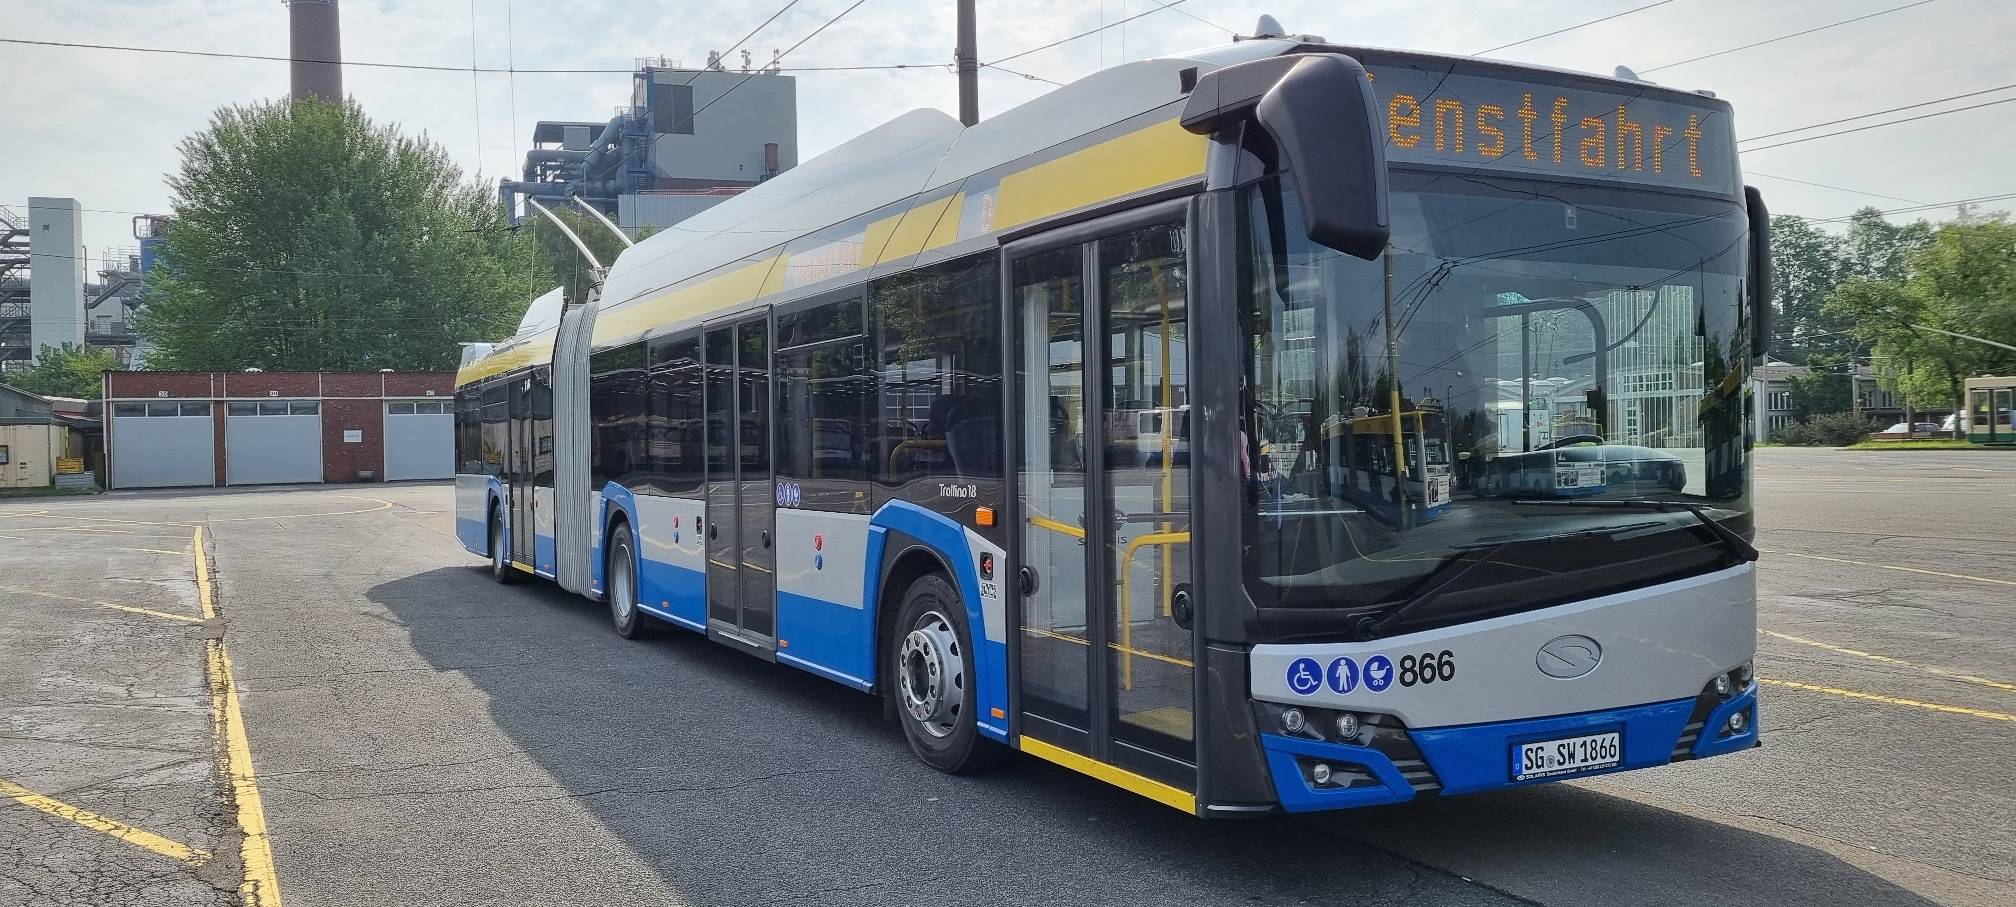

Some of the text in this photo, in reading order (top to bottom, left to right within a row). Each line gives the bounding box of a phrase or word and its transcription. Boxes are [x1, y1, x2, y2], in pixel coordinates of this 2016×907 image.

[1367, 72, 1702, 177] enstfahrt
[938, 483, 977, 498] Trollino 18
[1399, 650, 1455, 687] 866
[1524, 736, 1617, 771] SG SW 1866
